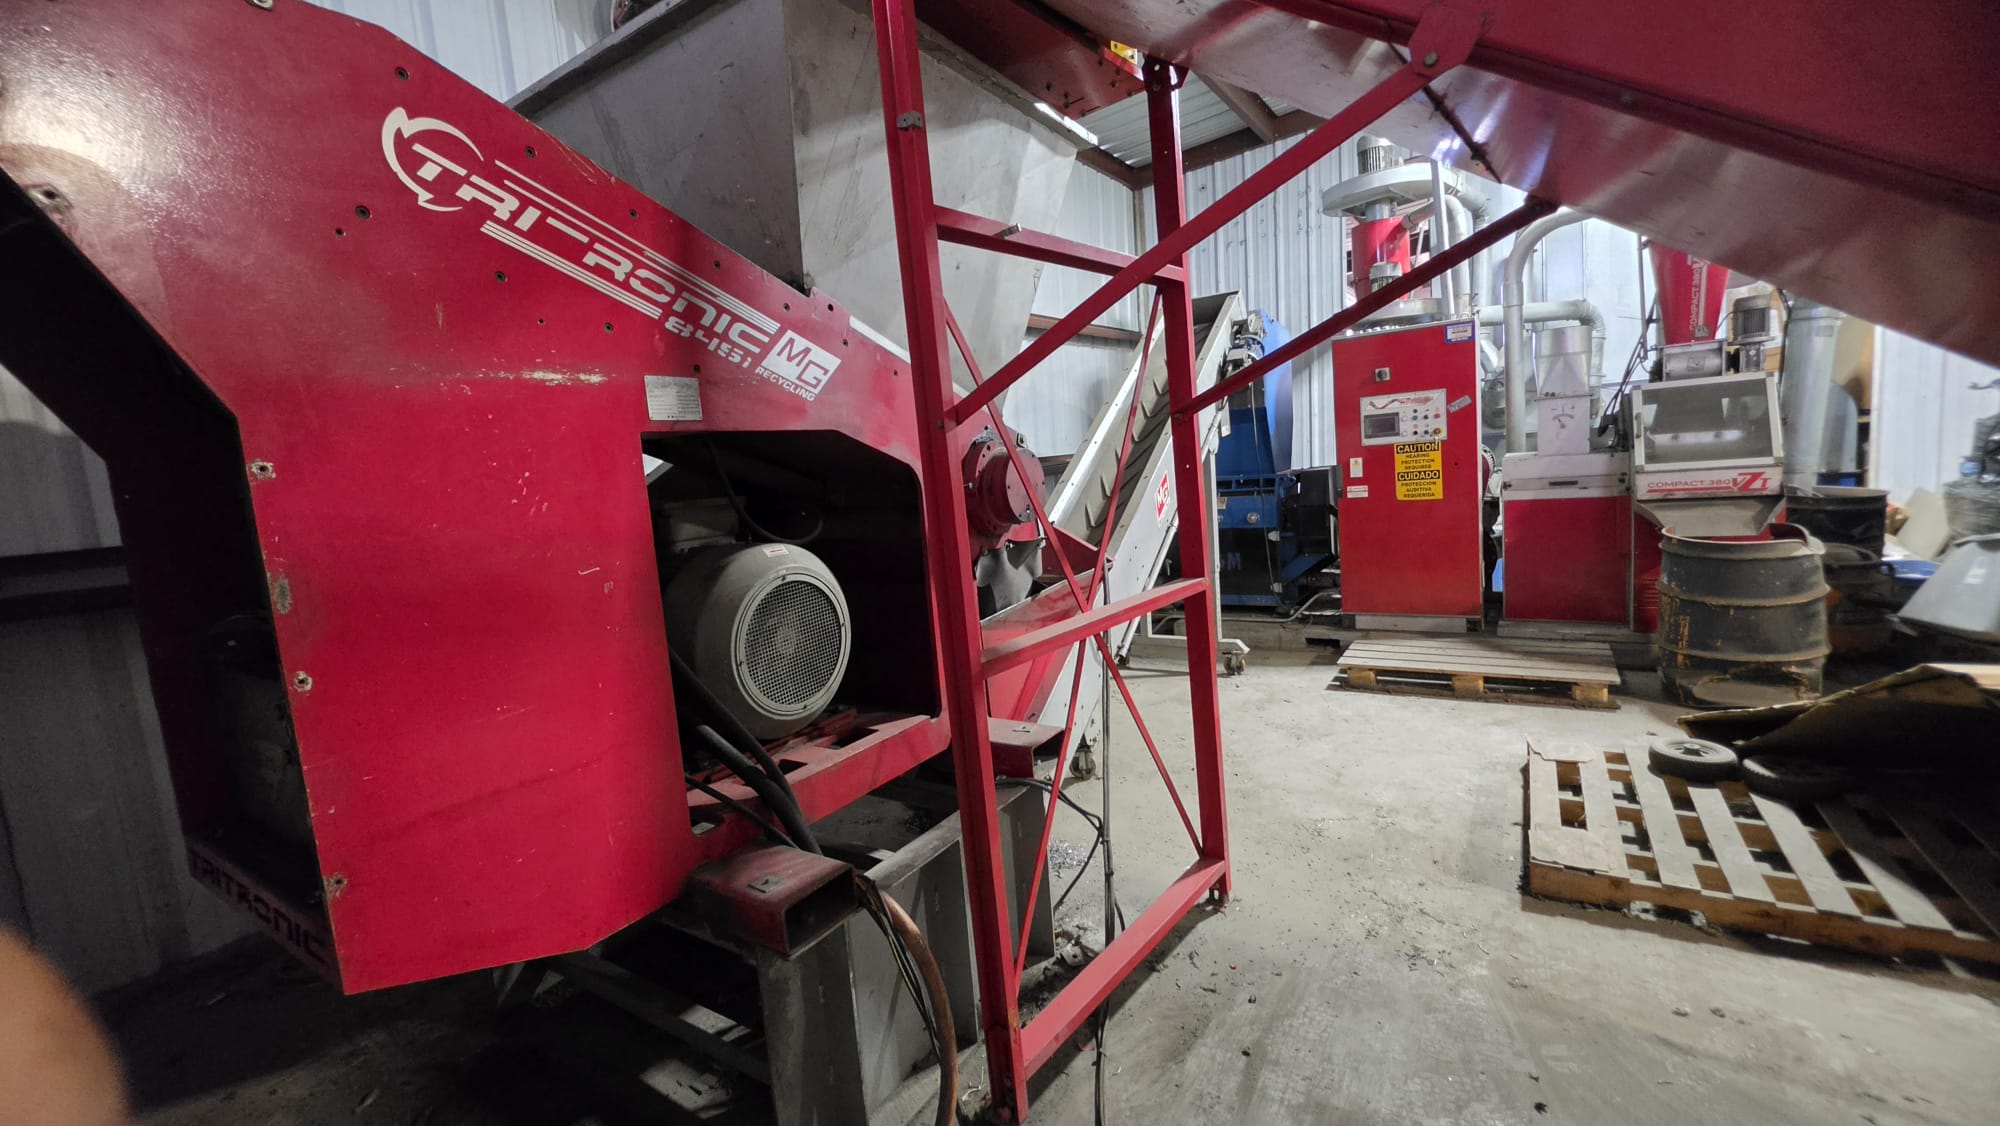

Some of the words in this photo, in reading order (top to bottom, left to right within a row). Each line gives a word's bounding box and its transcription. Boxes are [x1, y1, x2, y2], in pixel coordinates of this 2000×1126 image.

[774, 335, 831, 393] MG
[755, 366, 816, 401] RECYCLING
[1397, 443, 1438, 453] CAUTION
[1398, 470, 1439, 480] CUIDADO
[1647, 480, 1704, 489] COMPACT
